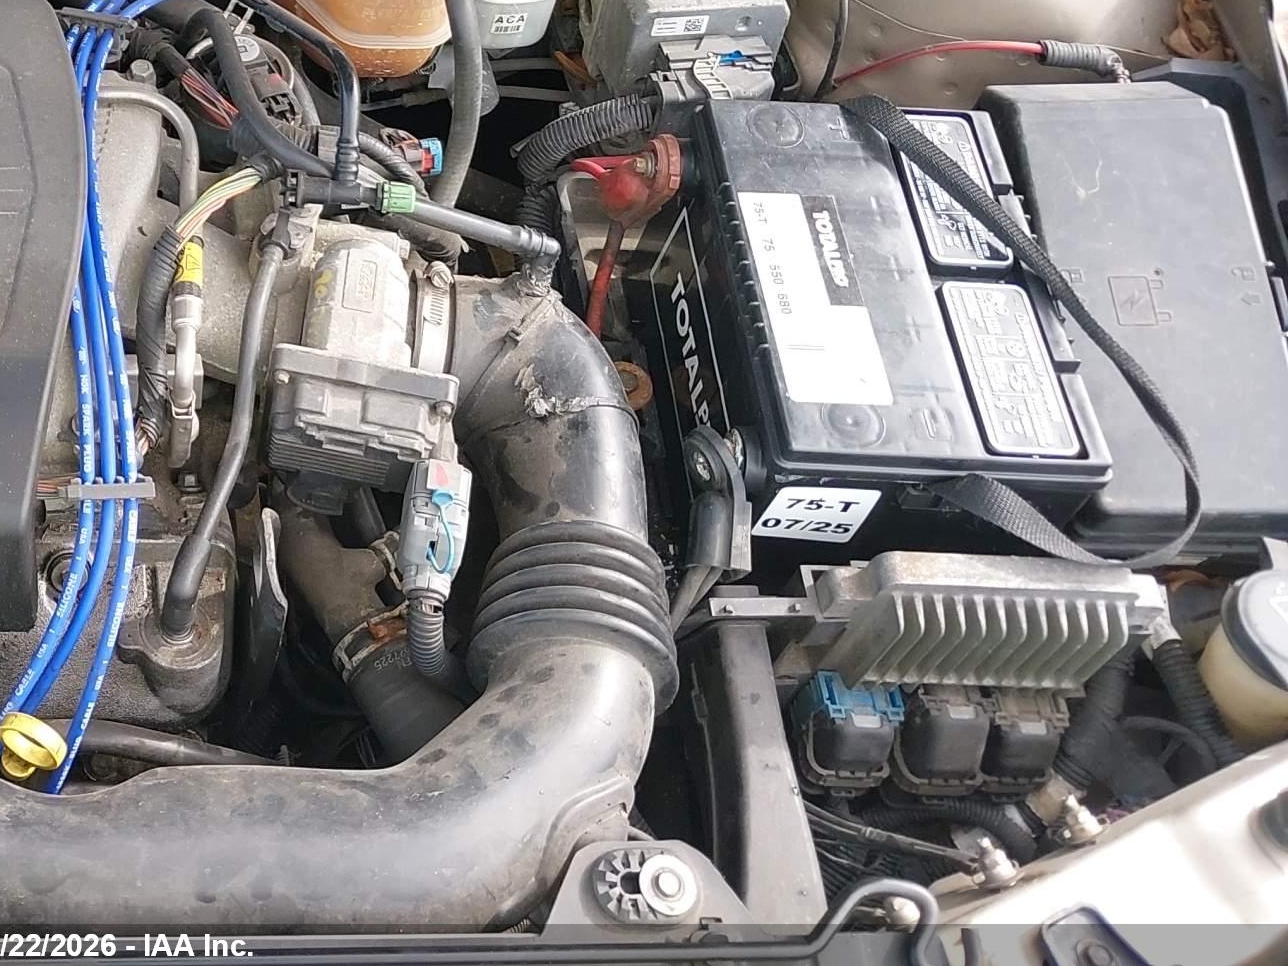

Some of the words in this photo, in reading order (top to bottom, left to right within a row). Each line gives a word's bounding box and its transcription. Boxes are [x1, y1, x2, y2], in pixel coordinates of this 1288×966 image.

[494, 15, 525, 24] ACA
[753, 201, 768, 224] 75-T
[762, 238, 775, 252] 75
[671, 272, 712, 429] TOTALP
[785, 497, 861, 513] 75-T
[761, 517, 854, 535] 07/25
[79, 527, 88, 545] USA
[14, 669, 35, 697] CABLE
[37, 643, 48, 659] USA
[56, 572, 78, 619] SILICONE
